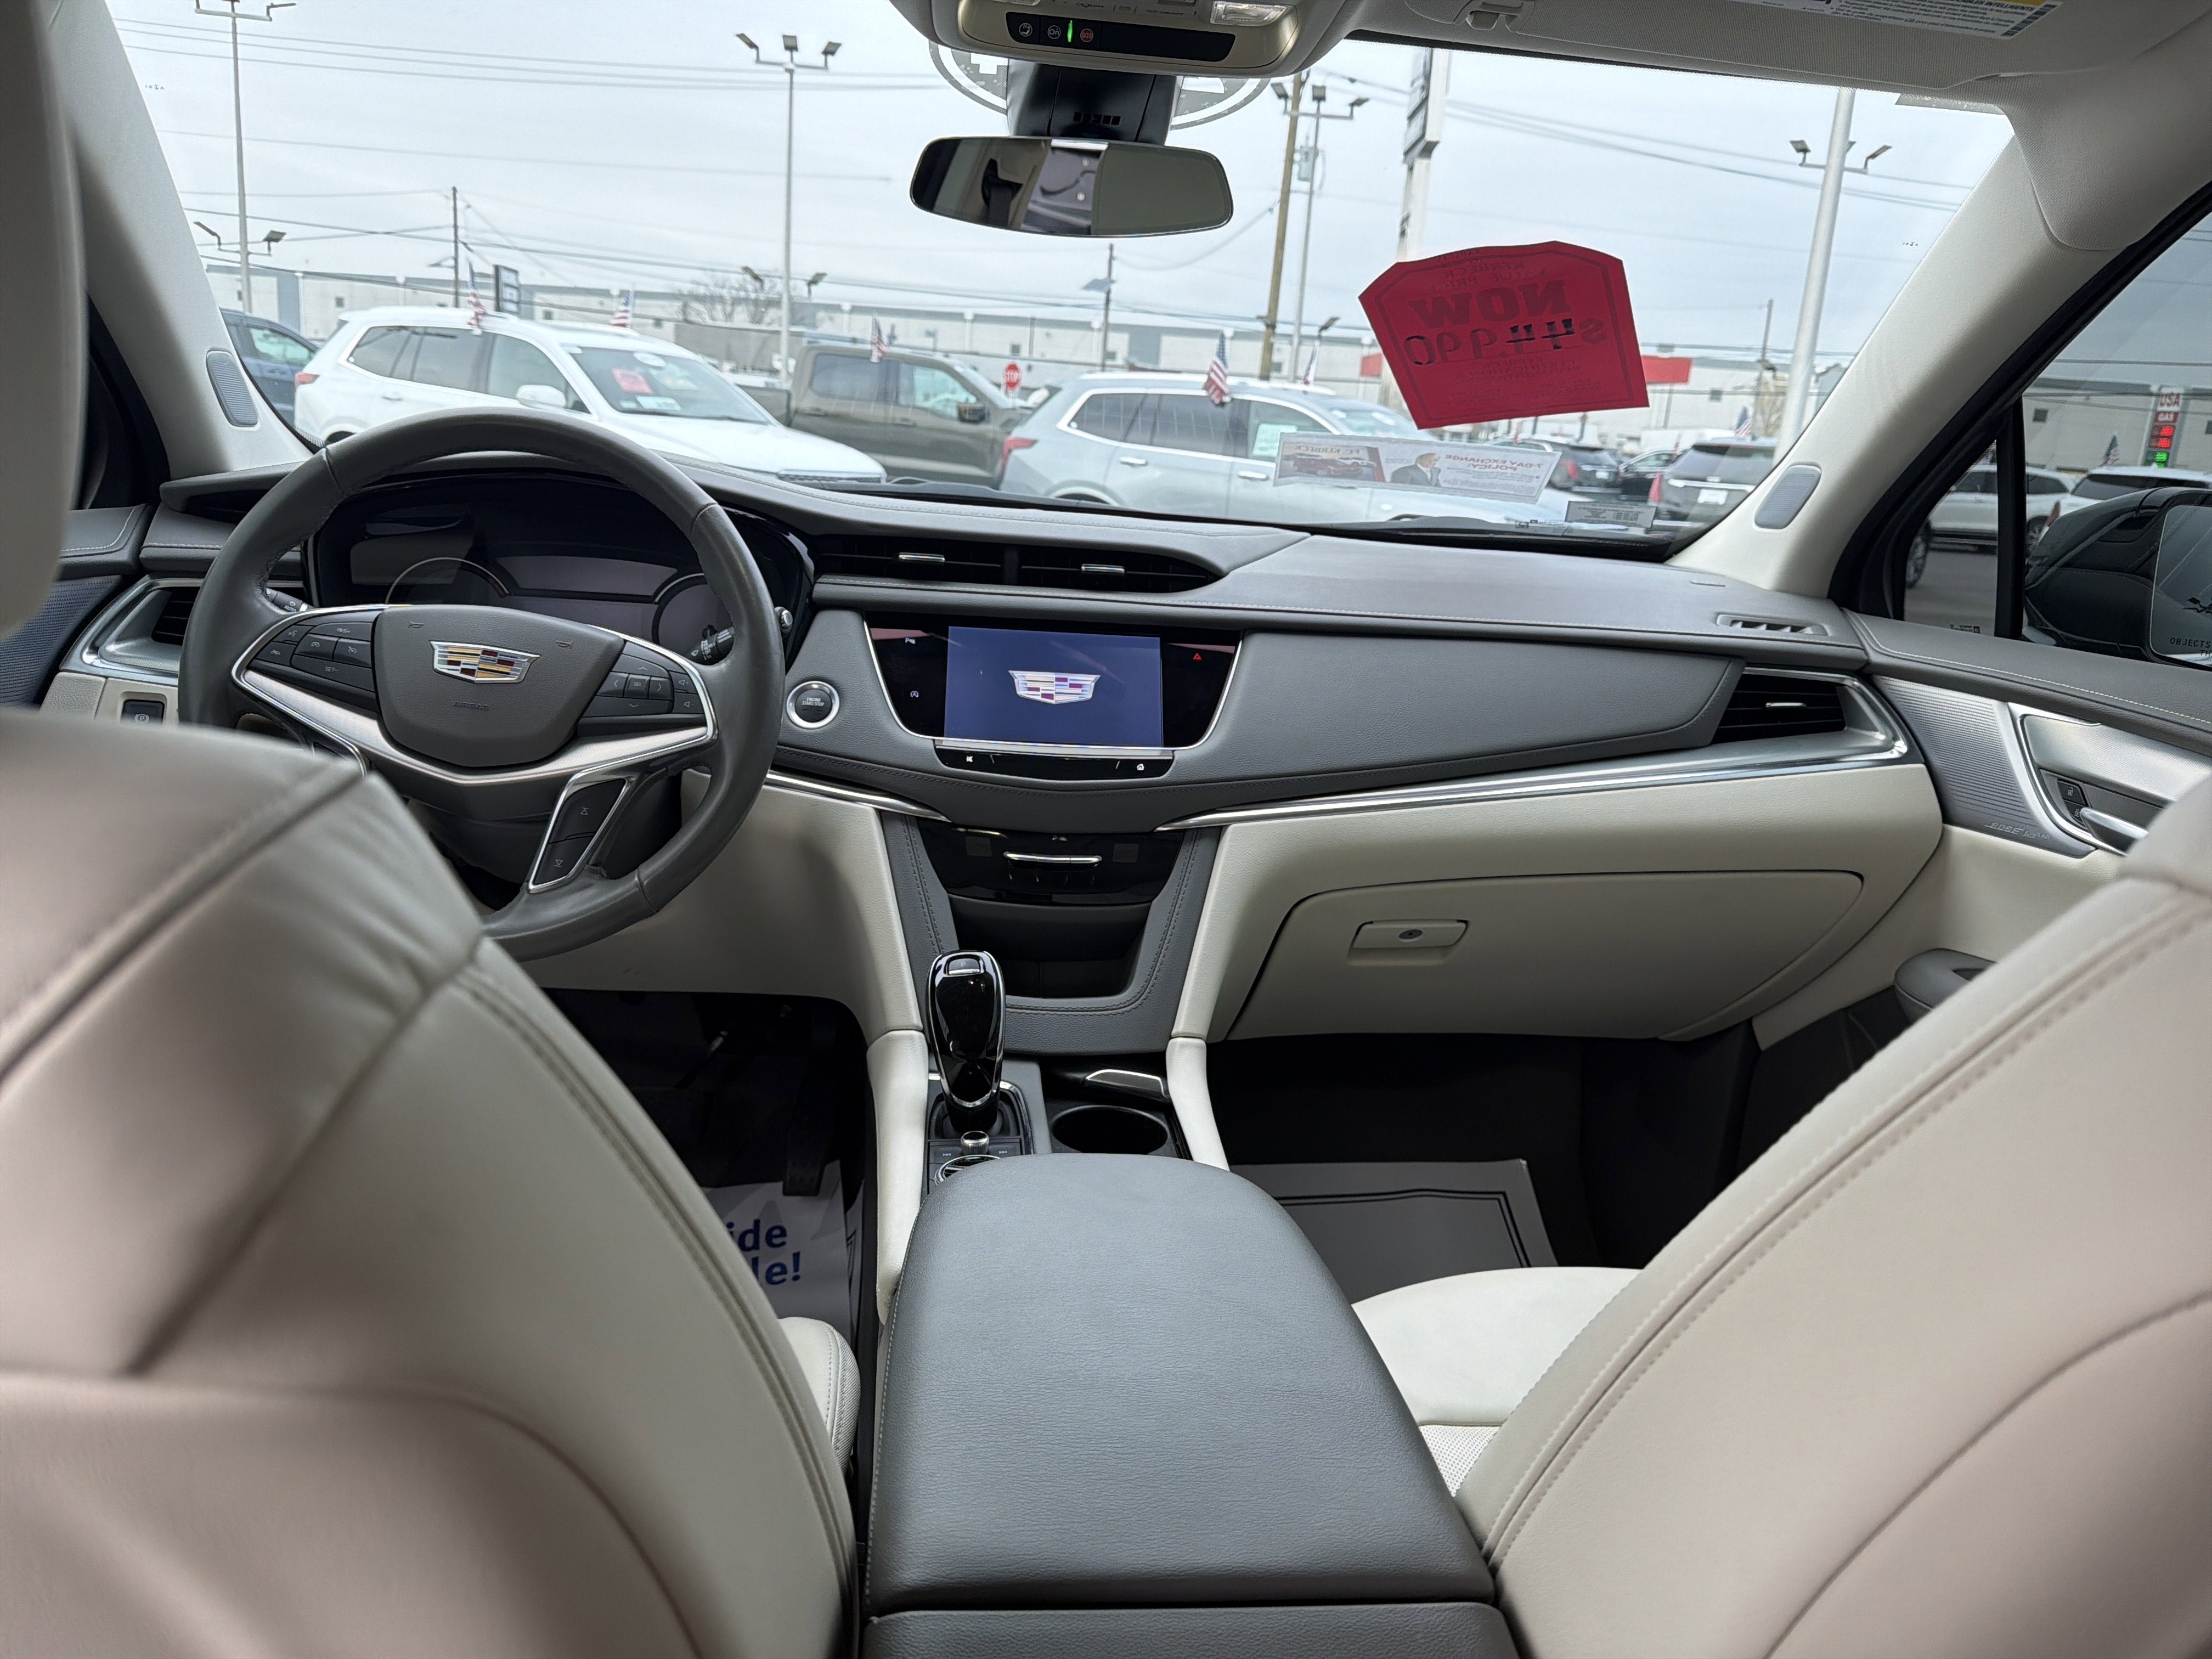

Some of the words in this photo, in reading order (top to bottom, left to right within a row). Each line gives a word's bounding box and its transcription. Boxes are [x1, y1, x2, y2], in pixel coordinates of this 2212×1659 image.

[2170, 637, 2211, 648] OBJECTS
[453, 700, 490, 712] AIRBAG
[1984, 822, 2025, 835] BOSE
